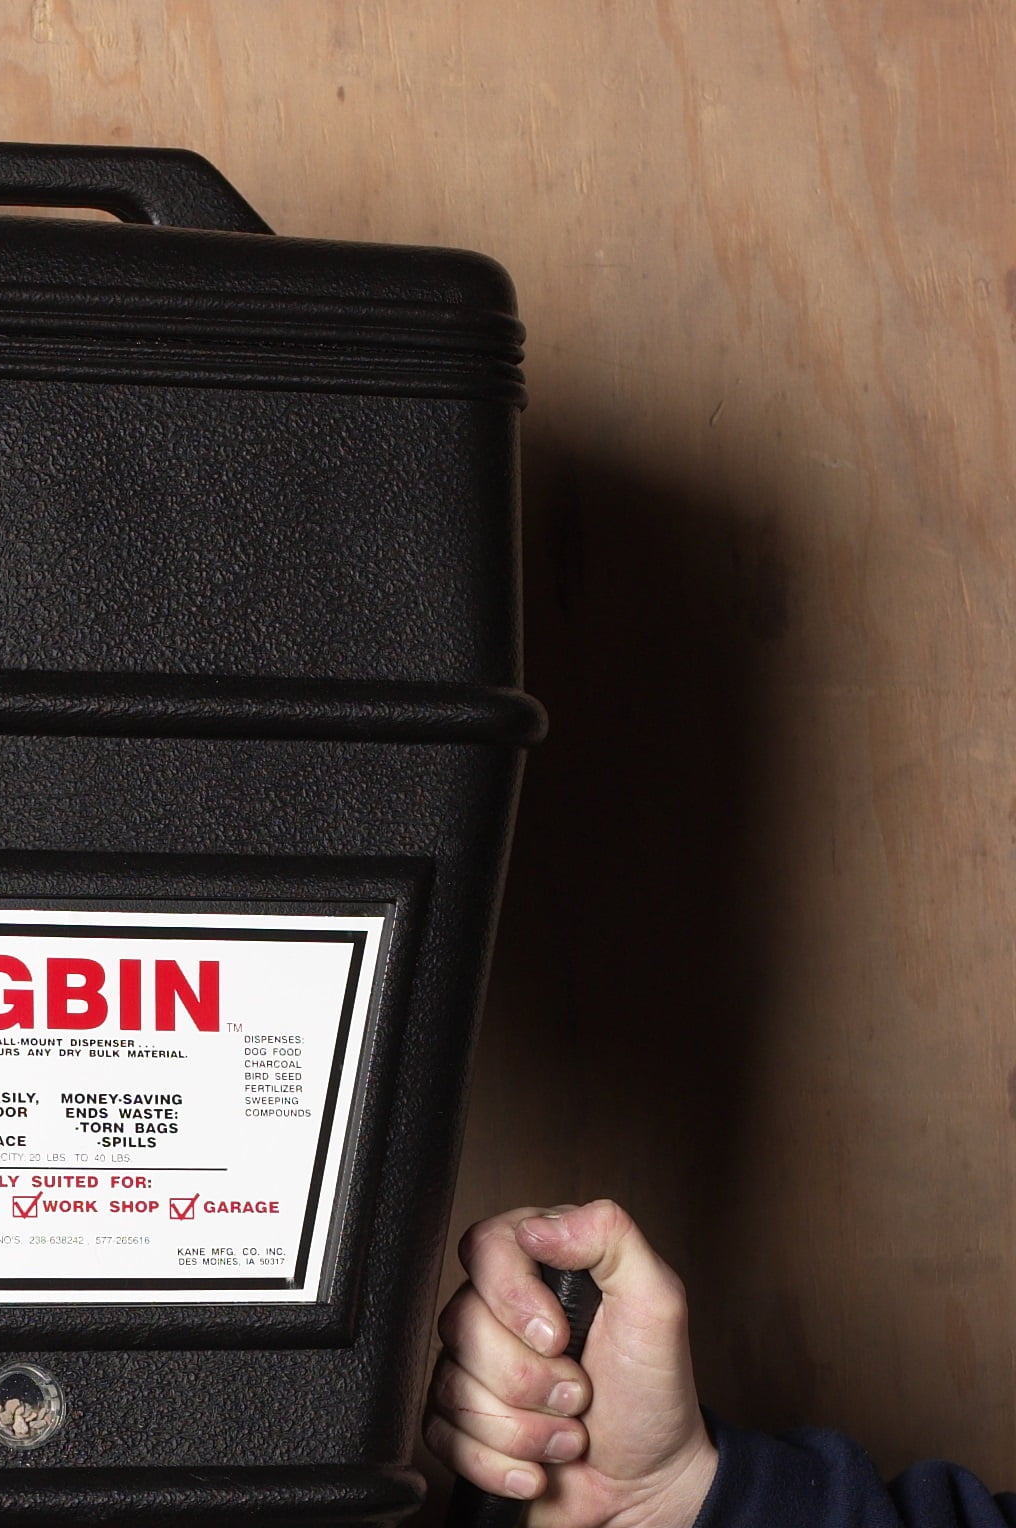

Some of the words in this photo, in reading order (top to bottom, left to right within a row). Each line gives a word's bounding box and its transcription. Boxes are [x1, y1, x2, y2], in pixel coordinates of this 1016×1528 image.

[226, 1023, 242, 1032] TM
[128, 1050, 187, 1058] MATERIAL.
[273, 1048, 301, 1056] FOOD
[245, 1060, 302, 1068] CHARCOAL
[245, 1085, 302, 1093] FERTILIZER
[61, 1093, 182, 1105] MONEY-SAVING
[245, 1097, 298, 1105] SWEEPING
[66, 1108, 108, 1118] ENDS
[119, 1108, 178, 1119] WASTE:
[245, 1109, 311, 1117] COMPOUNDS
[135, 1123, 178, 1133] BAGS
[74, 1154, 88, 1162] TO
[95, 1154, 105, 1162] 40
[32, 1176, 98, 1188] SUITED
[111, 1176, 151, 1188] FOR:
[43, 1200, 98, 1212] WORK
[110, 1201, 159, 1213] SHOP
[204, 1201, 279, 1213] GARAGE
[178, 1248, 205, 1256] KANE
[212, 1248, 235, 1256] MFG.
[243, 1248, 259, 1256] CO.
[203, 1258, 240, 1266] MOINES,
